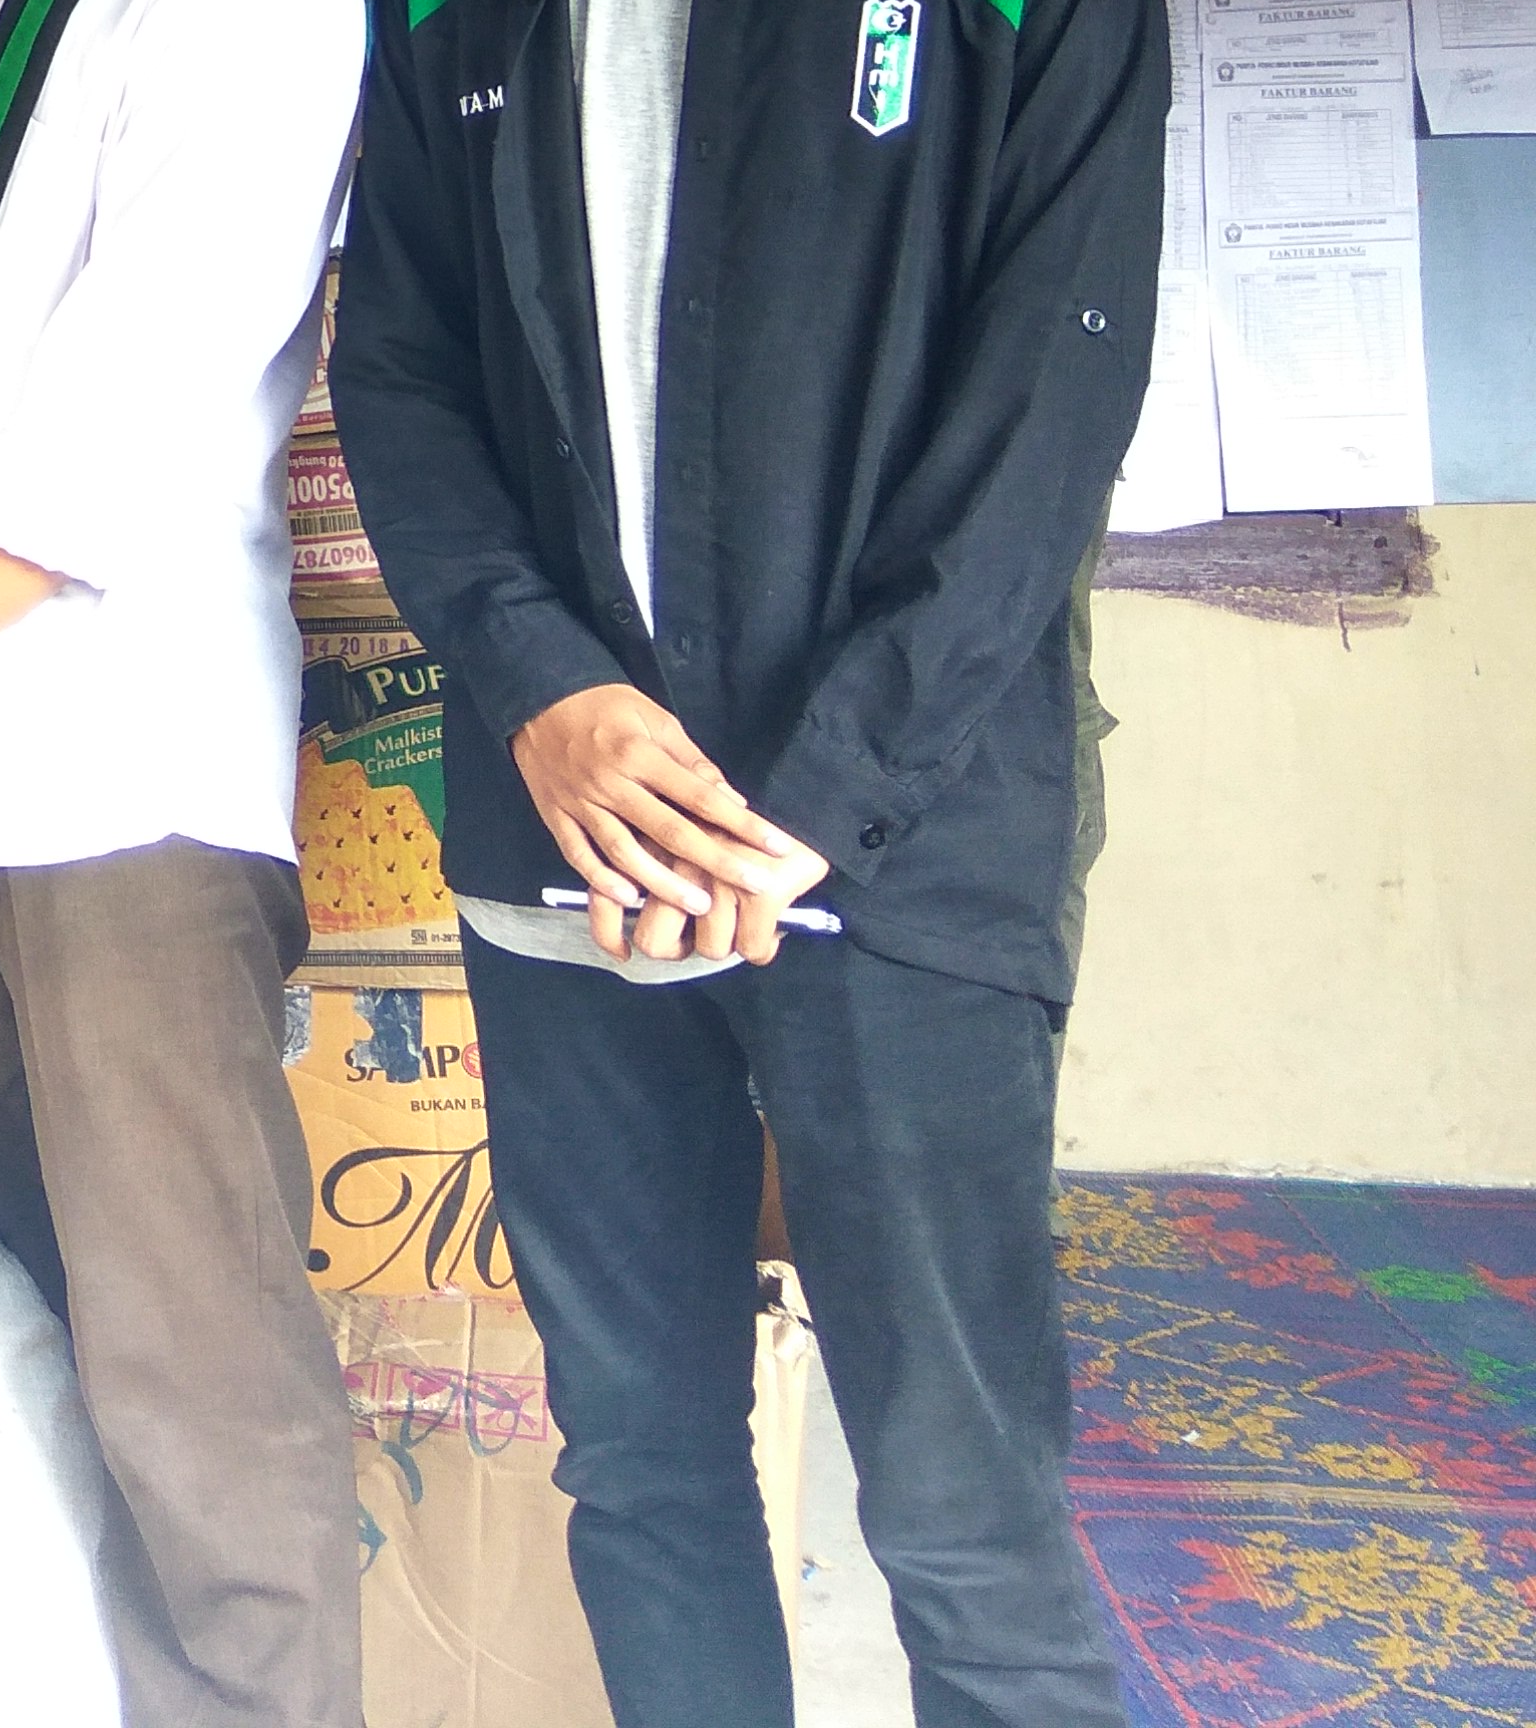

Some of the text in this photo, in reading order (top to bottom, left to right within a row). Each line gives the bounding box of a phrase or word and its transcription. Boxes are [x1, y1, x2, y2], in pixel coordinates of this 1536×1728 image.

[340, 636, 360, 656] 20
[368, 637, 388, 655] 18
[375, 725, 443, 756] Malkist
[364, 746, 443, 774] Crackers
[410, 1098, 467, 1112] BUKAN
